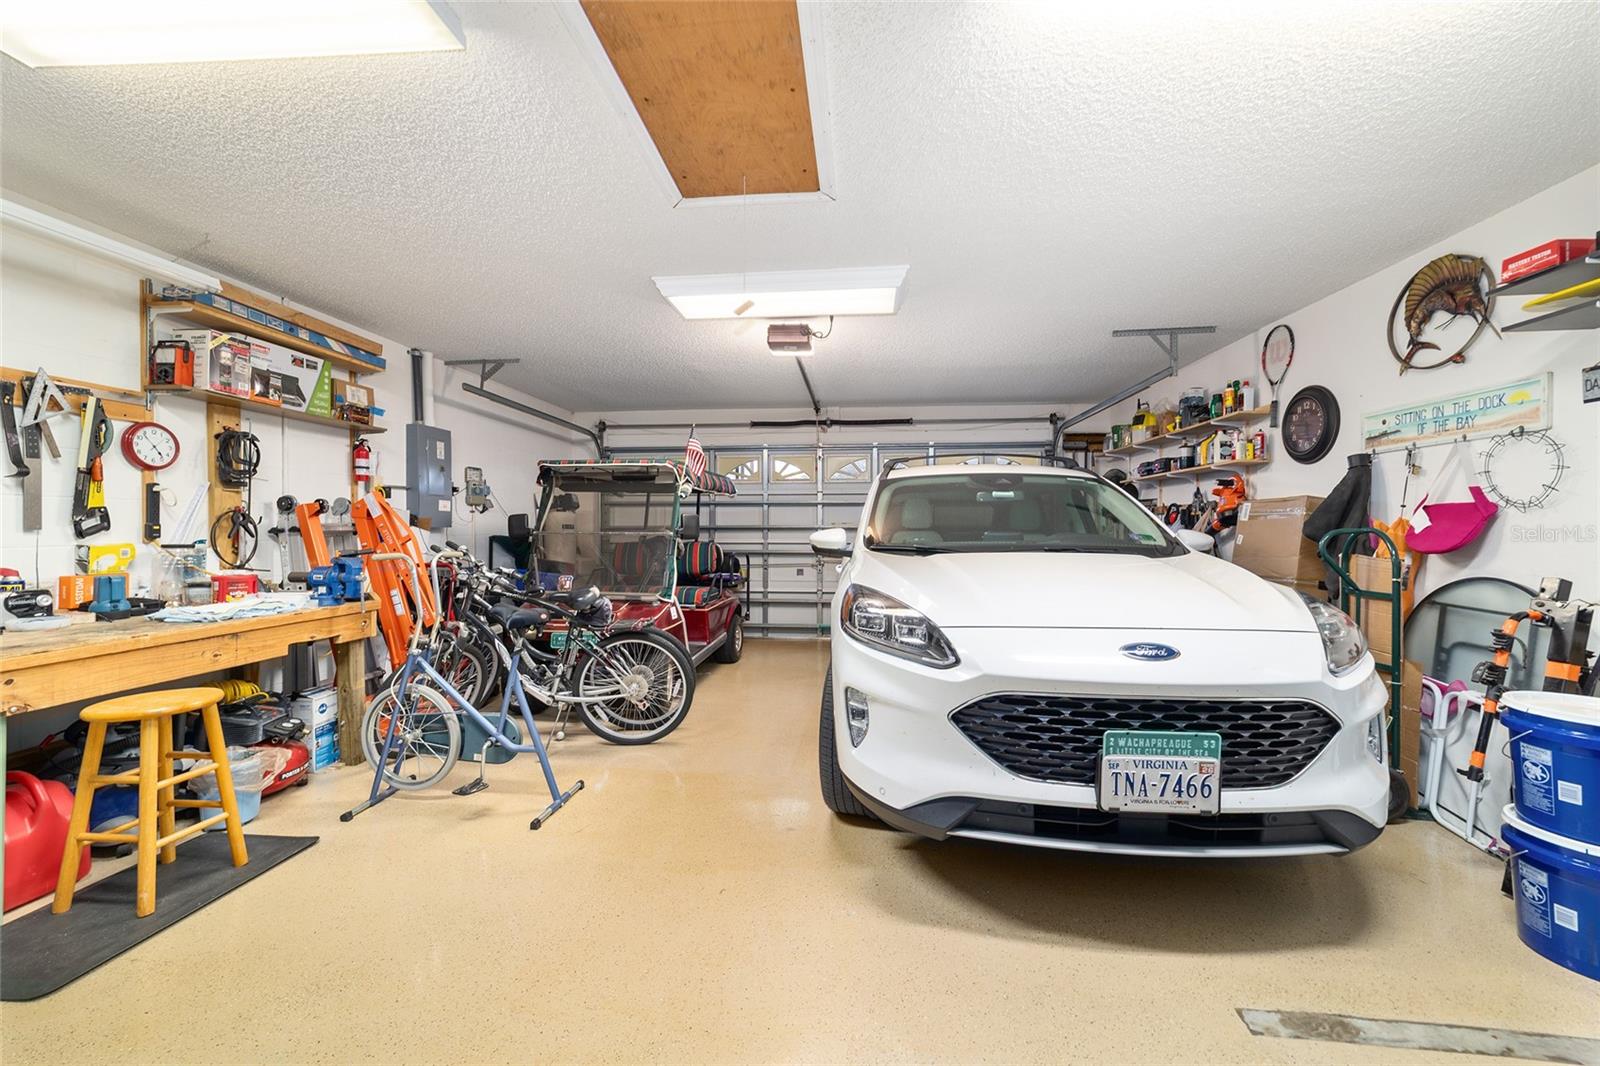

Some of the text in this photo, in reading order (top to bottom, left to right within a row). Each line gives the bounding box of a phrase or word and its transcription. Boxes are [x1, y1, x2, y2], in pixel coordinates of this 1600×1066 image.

[1395, 393, 1506, 426] SITTING ON THE DOCK
[1417, 414, 1478, 435] OF THE BAY
[1135, 644, 1168, 657] Ford
[1118, 738, 1192, 748] WACHAPREAGUE
[1133, 760, 1188, 770] VIRGINIA
[1111, 772, 1212, 798] TNA-7466
